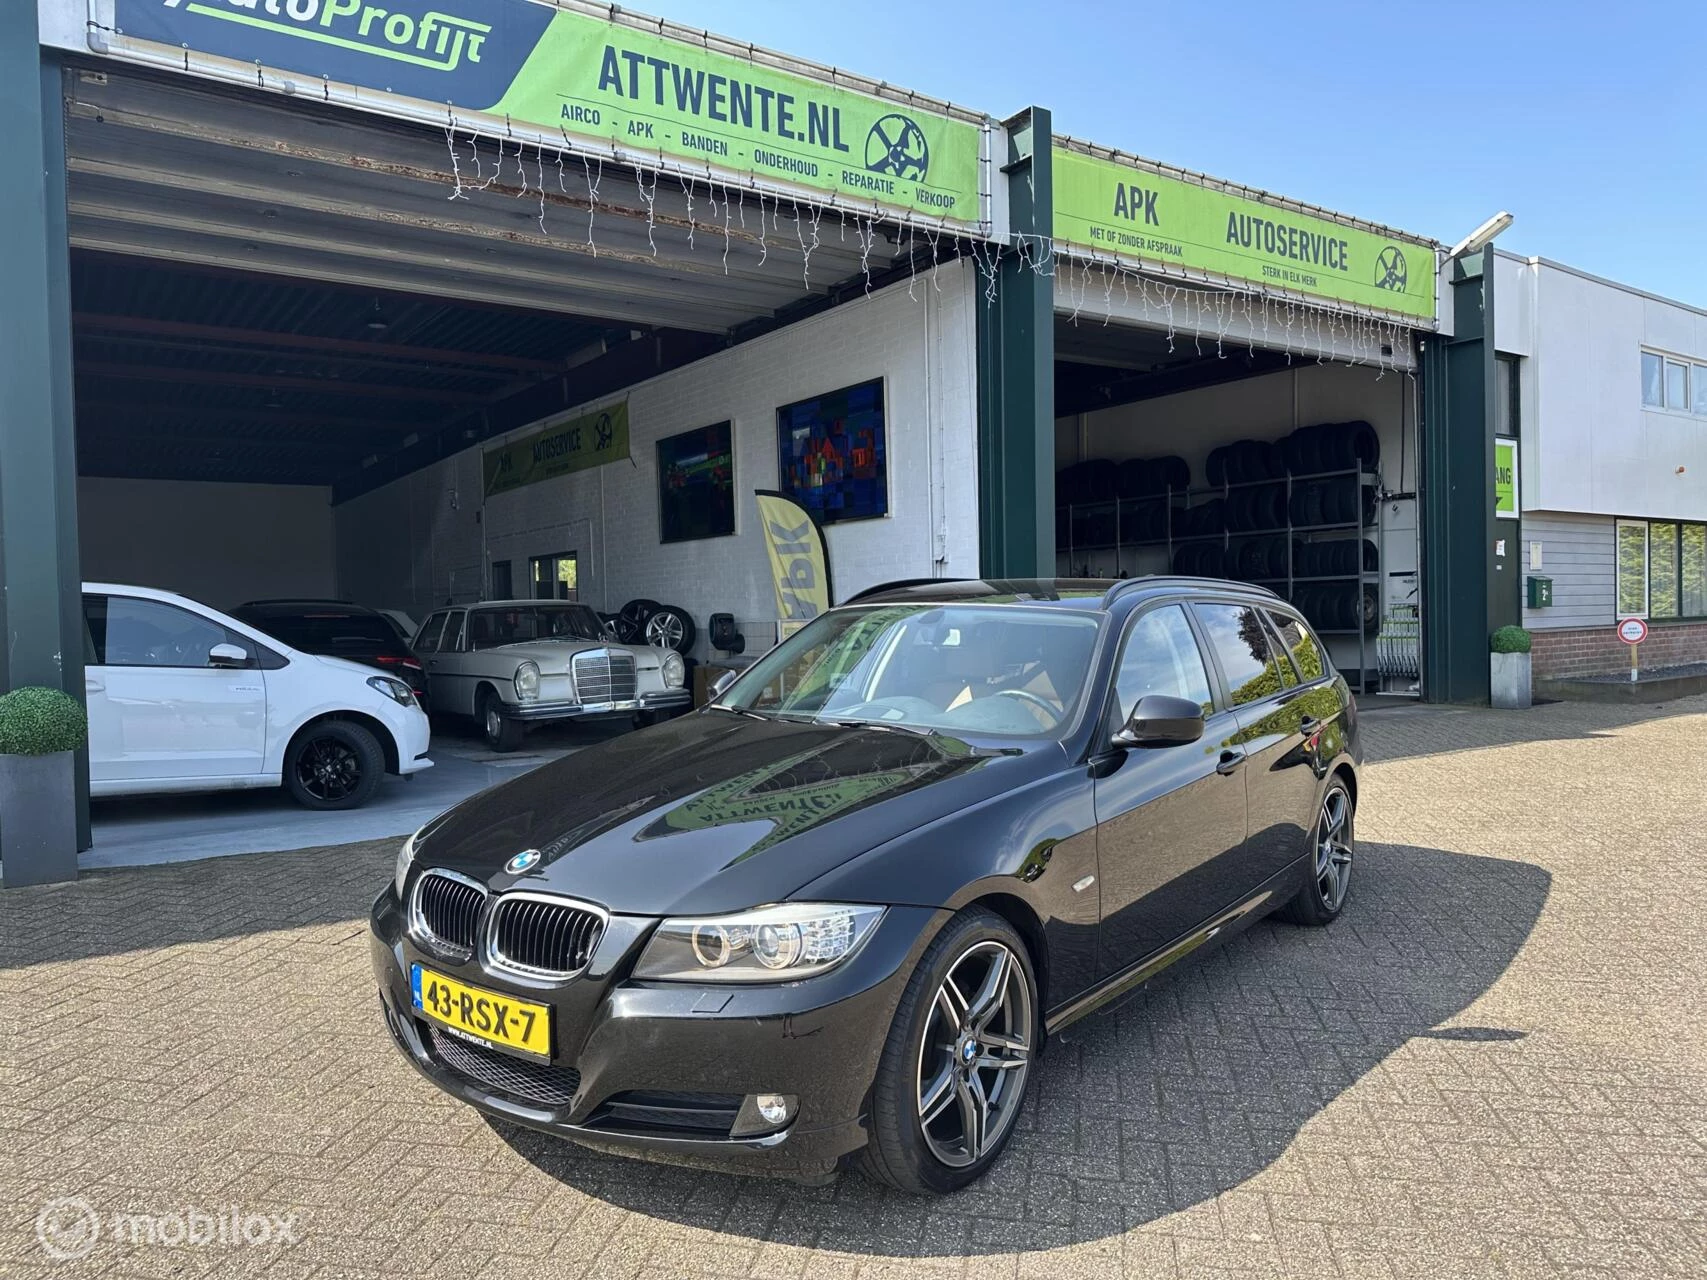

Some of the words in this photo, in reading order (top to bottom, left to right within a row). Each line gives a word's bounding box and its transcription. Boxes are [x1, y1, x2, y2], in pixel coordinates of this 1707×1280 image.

[599, 46, 849, 152] ATTWENTE.NL
[561, 104, 600, 125] AIRCO
[628, 120, 653, 139] APK
[682, 131, 727, 156] BANDEN
[754, 149, 818, 177] ONDERHOUD
[842, 170, 895, 195] REPARATIE
[916, 187, 955, 209] VERKOOP
[1114, 182, 1159, 226] APK
[1090, 227, 1105, 241] MET
[1107, 230, 1116, 243] OF
[1118, 233, 1145, 248] ZONDER
[1147, 237, 1183, 257] AFSPRAAK
[1226, 211, 1348, 271] AUTOSERVICE
[1262, 265, 1280, 279] STERK
[1282, 270, 1289, 281] IN
[1290, 271, 1300, 282] ELK
[532, 428, 581, 464] AUTOSERVICE
[427, 980, 536, 1045] 43-RSX-7
